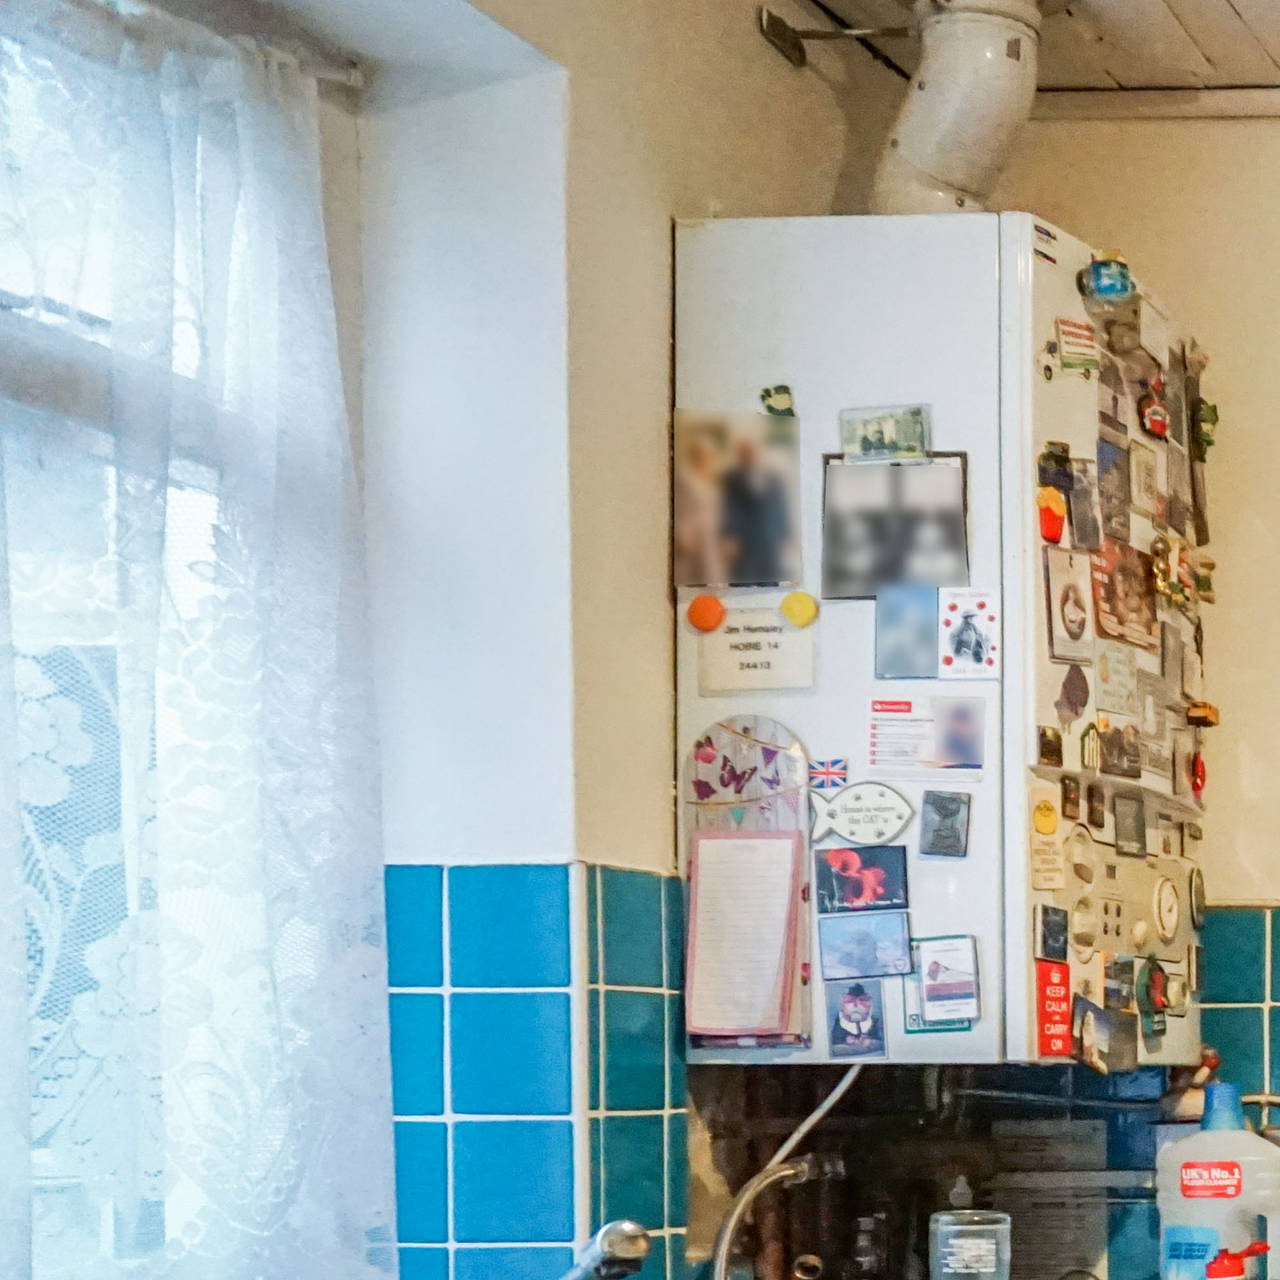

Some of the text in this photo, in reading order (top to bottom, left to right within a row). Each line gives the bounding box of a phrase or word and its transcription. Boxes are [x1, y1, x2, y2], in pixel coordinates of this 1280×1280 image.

[1046, 985, 1066, 997] KEEP
[1045, 1000, 1068, 1012] CALM
[1044, 1023, 1069, 1035] CARRY
[1051, 1039, 1063, 1050] ON
[1210, 1167, 1241, 1179] No.1
